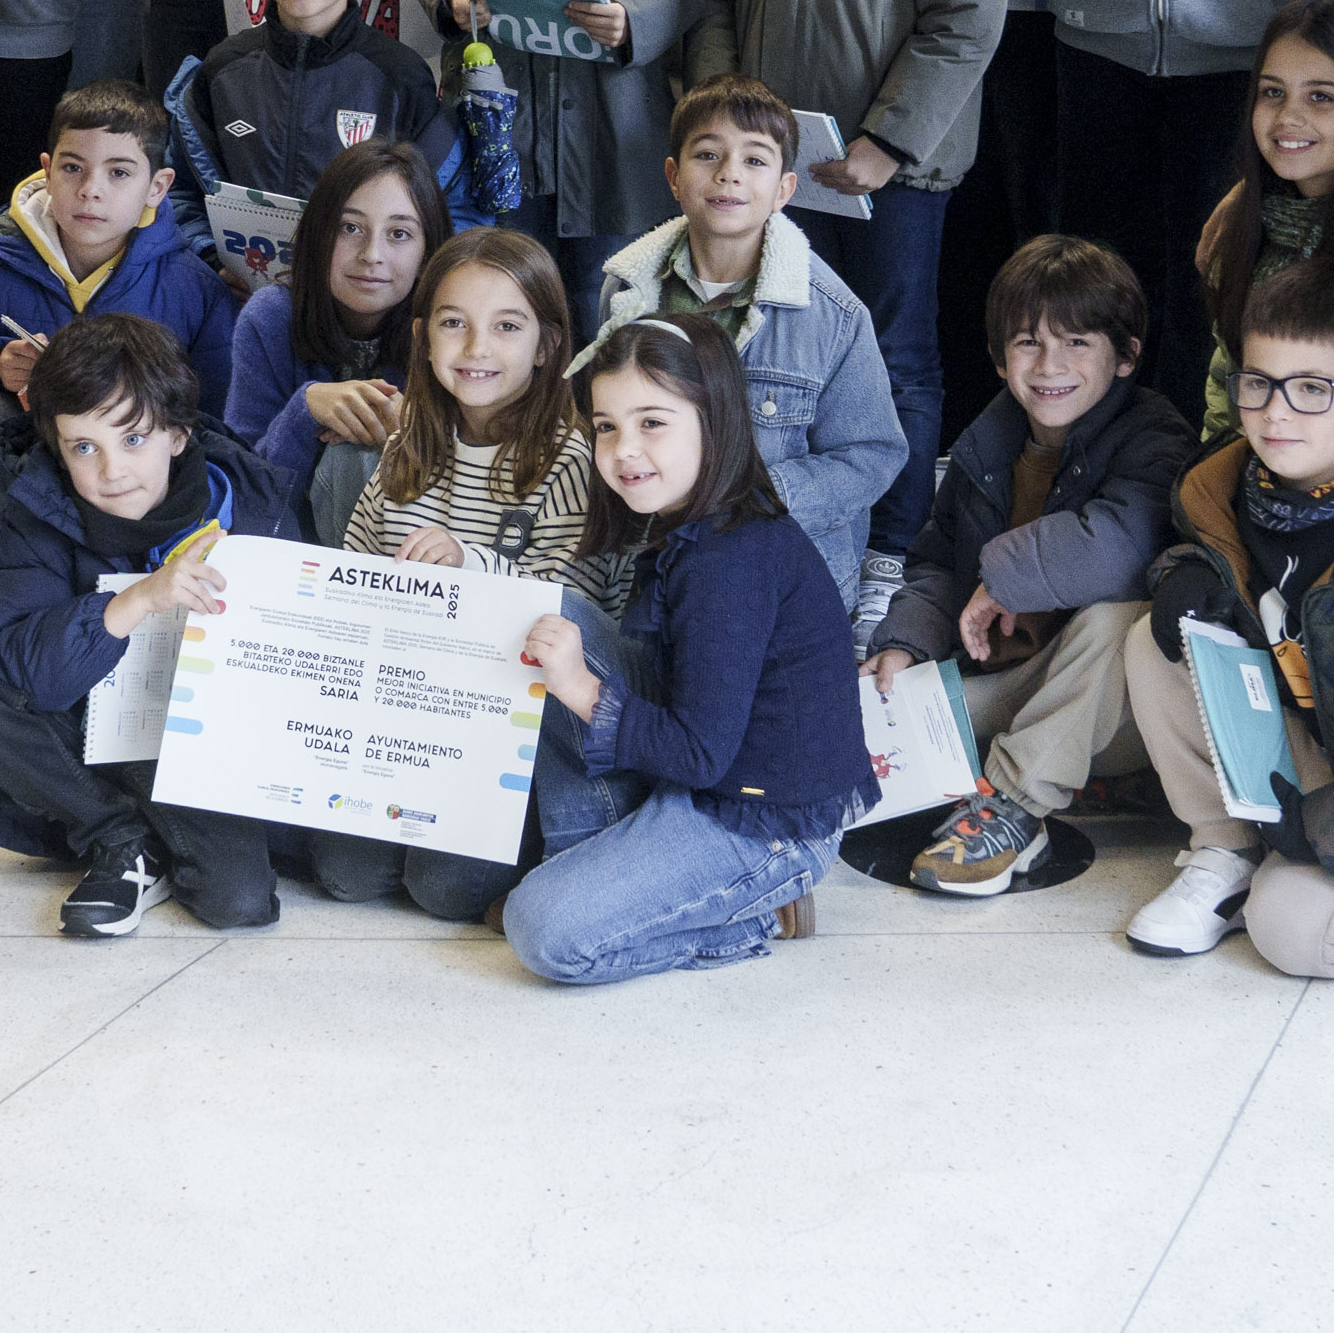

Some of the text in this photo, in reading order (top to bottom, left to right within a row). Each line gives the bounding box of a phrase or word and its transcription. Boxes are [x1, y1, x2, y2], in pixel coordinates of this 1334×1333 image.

[328, 566, 460, 620] ASTEKLIMA 2025
[230, 639, 365, 668] 5.000 ETA 20.000 BIZTANLE
[243, 651, 364, 678] BITARTEKO UDALERRI EDO
[226, 658, 362, 687] ESKUALDEKO EKIMEN ONENA
[378, 664, 426, 681] PREMIO
[320, 685, 359, 701] SARIA
[375, 686, 509, 715] O COMARCA CON ENTRE 5.000
[377, 677, 512, 706] MEJOR INICIATIVA EN MUNICIPIO
[373, 696, 471, 719] Y 20.000 HABITANTES
[286, 720, 353, 741] ERMUAKO
[304, 737, 350, 754] UDALA
[366, 734, 463, 760] AYUNTAMIENTO
[365, 748, 430, 768] DE ERMUA
[344, 796, 373, 810] ihobe
